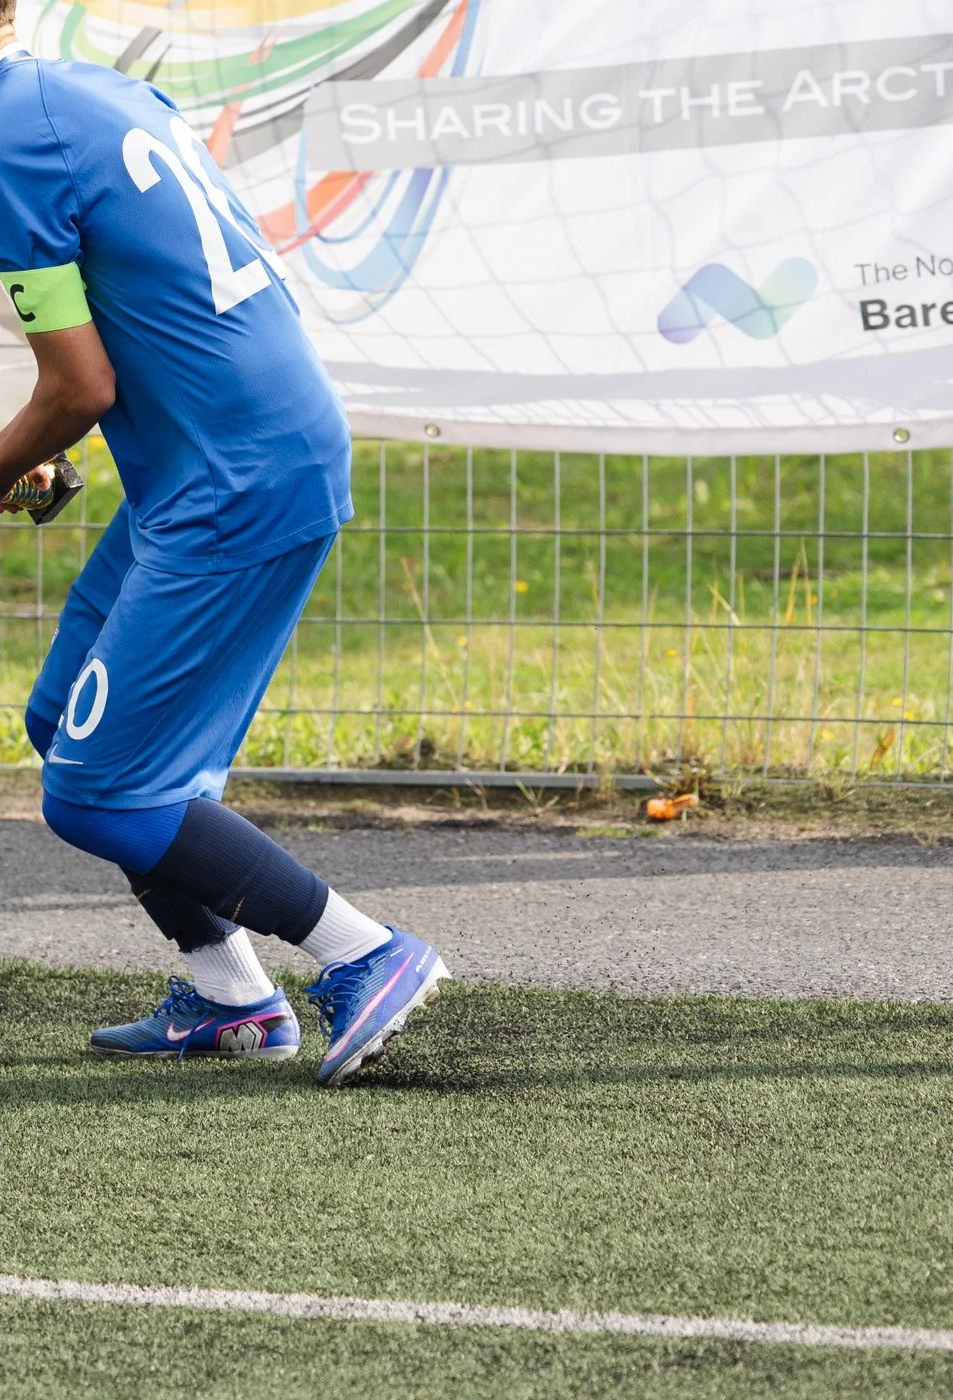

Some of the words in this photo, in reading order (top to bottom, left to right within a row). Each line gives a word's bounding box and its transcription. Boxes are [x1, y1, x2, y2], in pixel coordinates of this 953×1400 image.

[339, 92, 623, 144] SHARING
[638, 80, 764, 123] THE
[782, 61, 953, 112] ARCT
[854, 261, 908, 286] The
[916, 254, 953, 278] No
[9, 283, 37, 323] C
